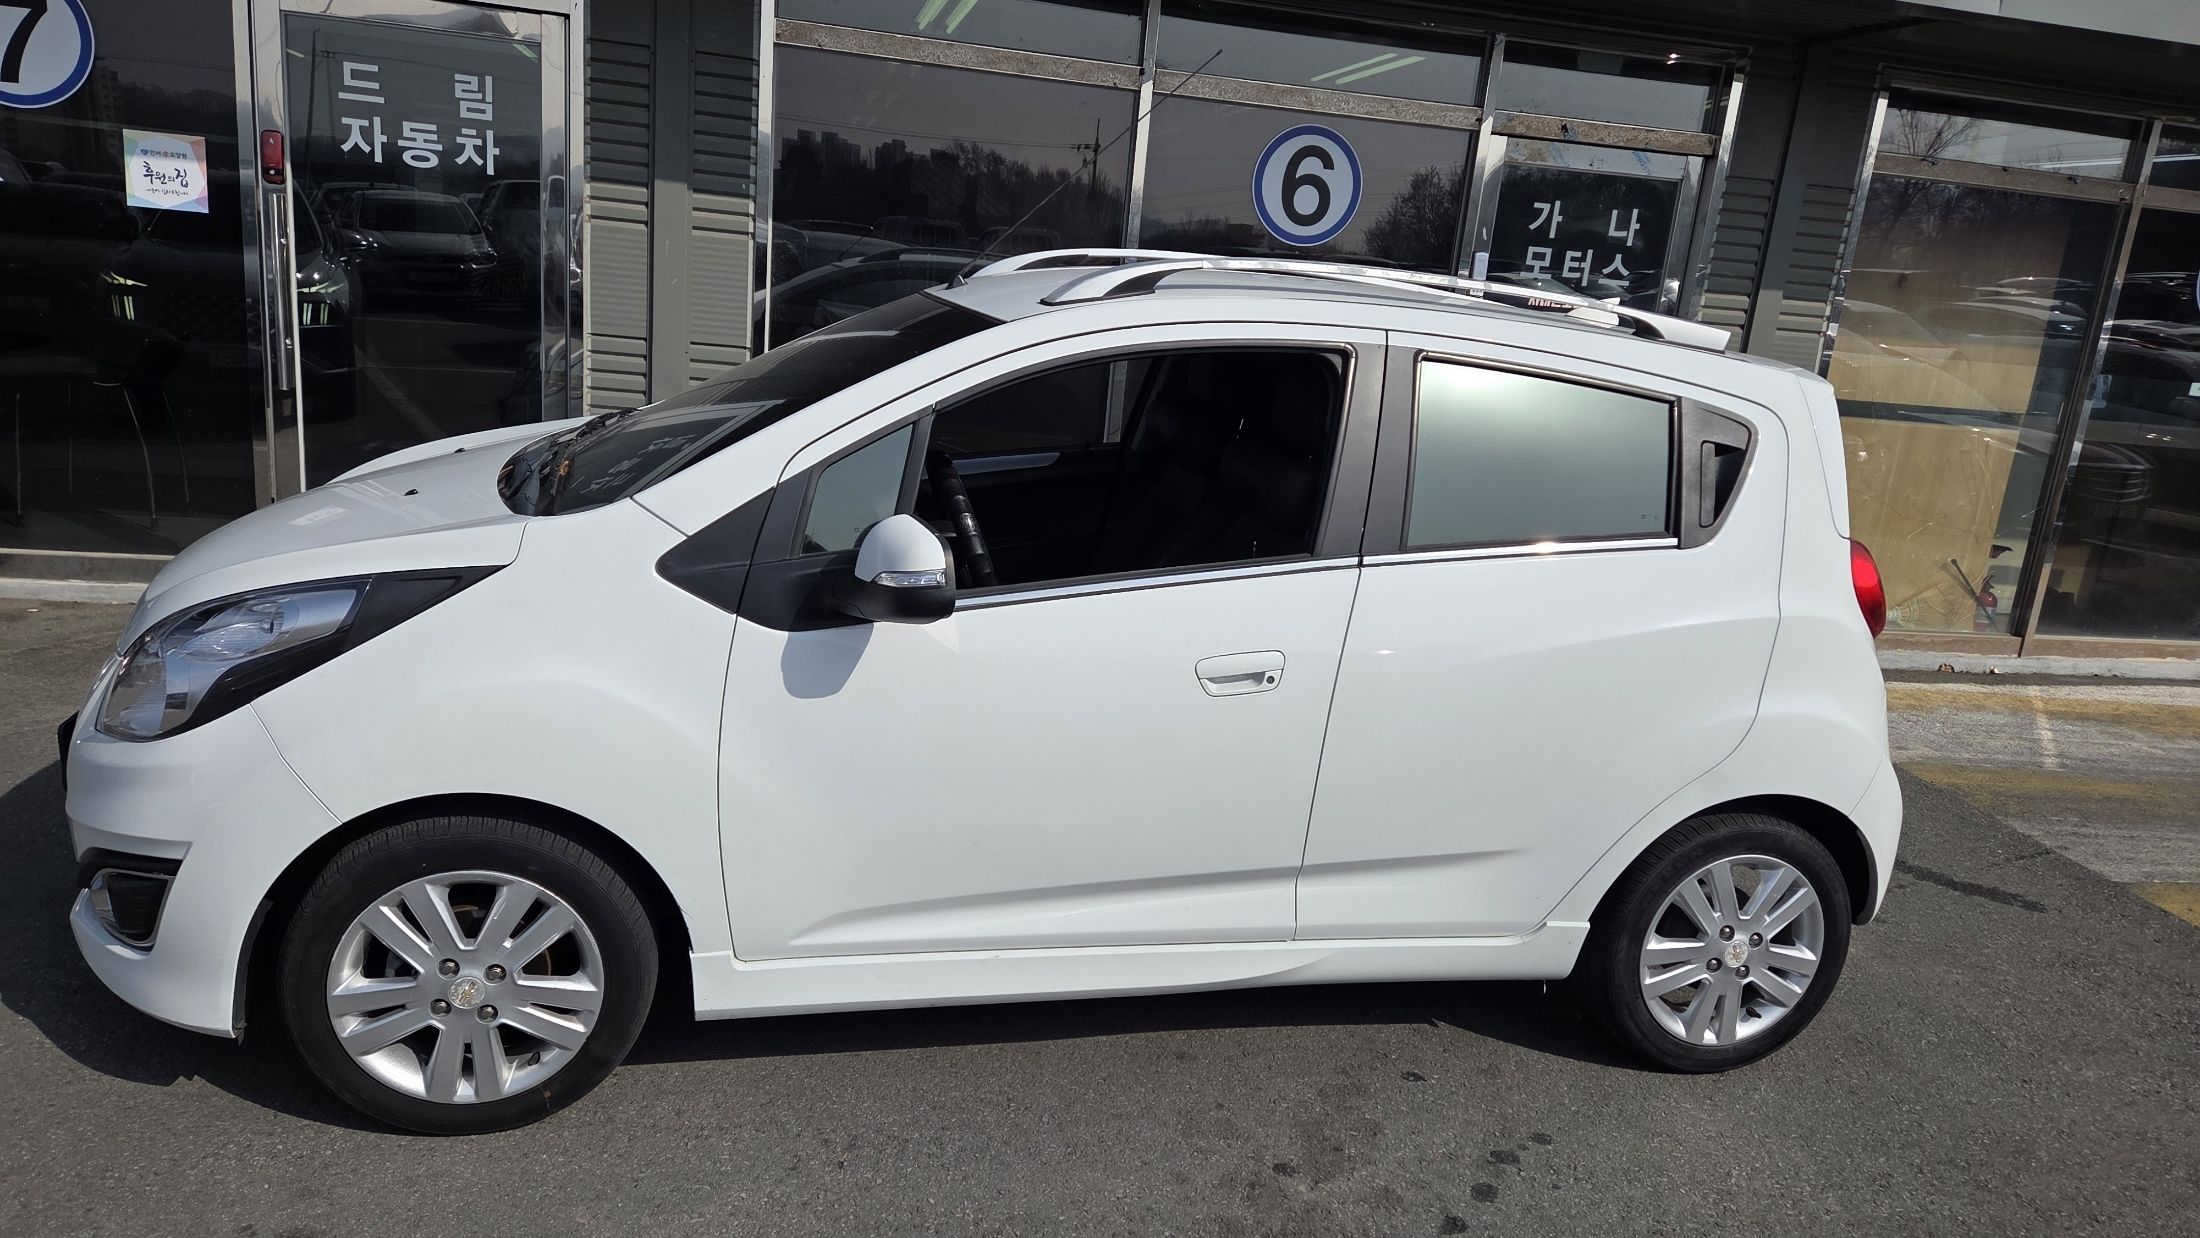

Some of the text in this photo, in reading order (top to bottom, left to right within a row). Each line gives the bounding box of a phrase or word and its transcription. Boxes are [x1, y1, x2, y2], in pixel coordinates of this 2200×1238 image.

[0, 0, 47, 83] 7
[340, 116, 500, 176] 자동차
[1281, 144, 1335, 227] 6
[1520, 245, 1630, 287] 모터스
